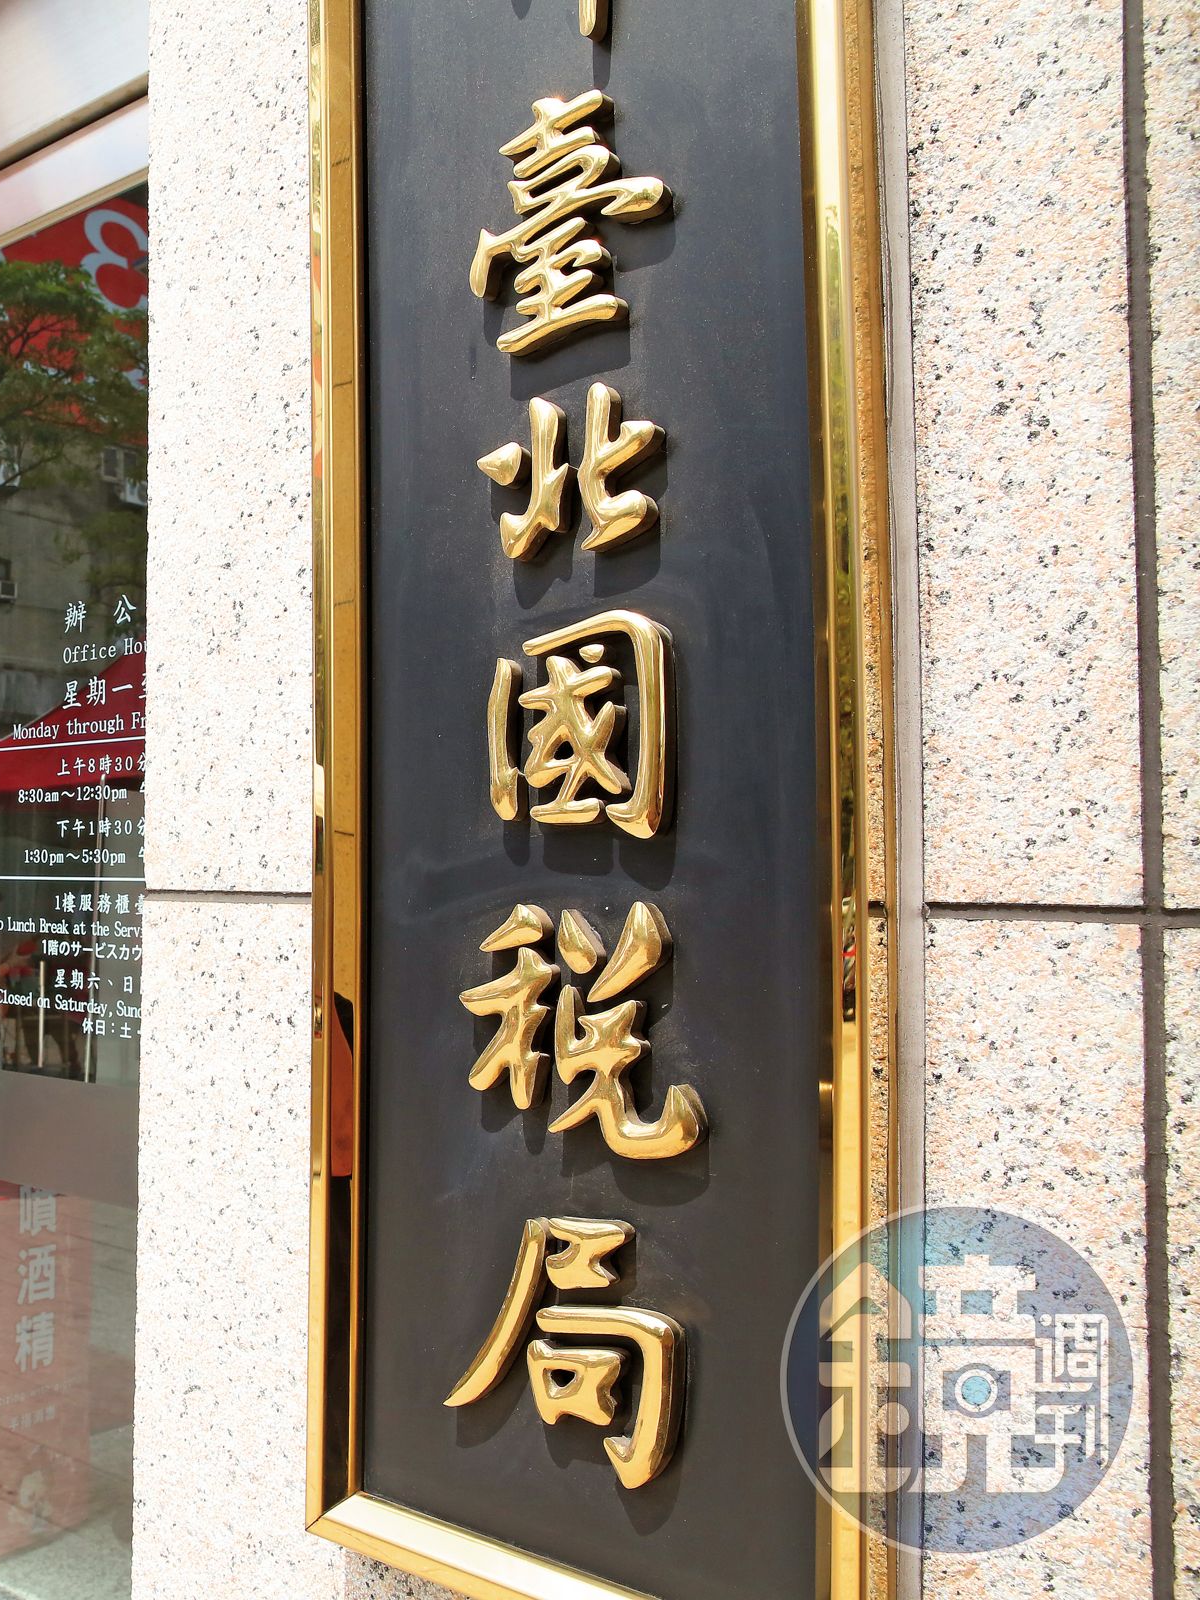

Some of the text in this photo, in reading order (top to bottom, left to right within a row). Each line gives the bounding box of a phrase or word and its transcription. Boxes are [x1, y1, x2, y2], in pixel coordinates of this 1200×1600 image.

[64, 594, 137, 633] 辦公
[63, 643, 116, 664] Office
[13, 722, 60, 740] Monday
[67, 713, 125, 735] through
[7, 916, 36, 933] Lunch
[39, 917, 70, 935] Break
[72, 921, 86, 936] at
[91, 921, 110, 937] the
[54, 968, 142, 995] 星期六、日
[37, 996, 51, 1009] on
[54, 993, 113, 1018] Saturday,
[15, 1185, 57, 1373] 噴酒精
